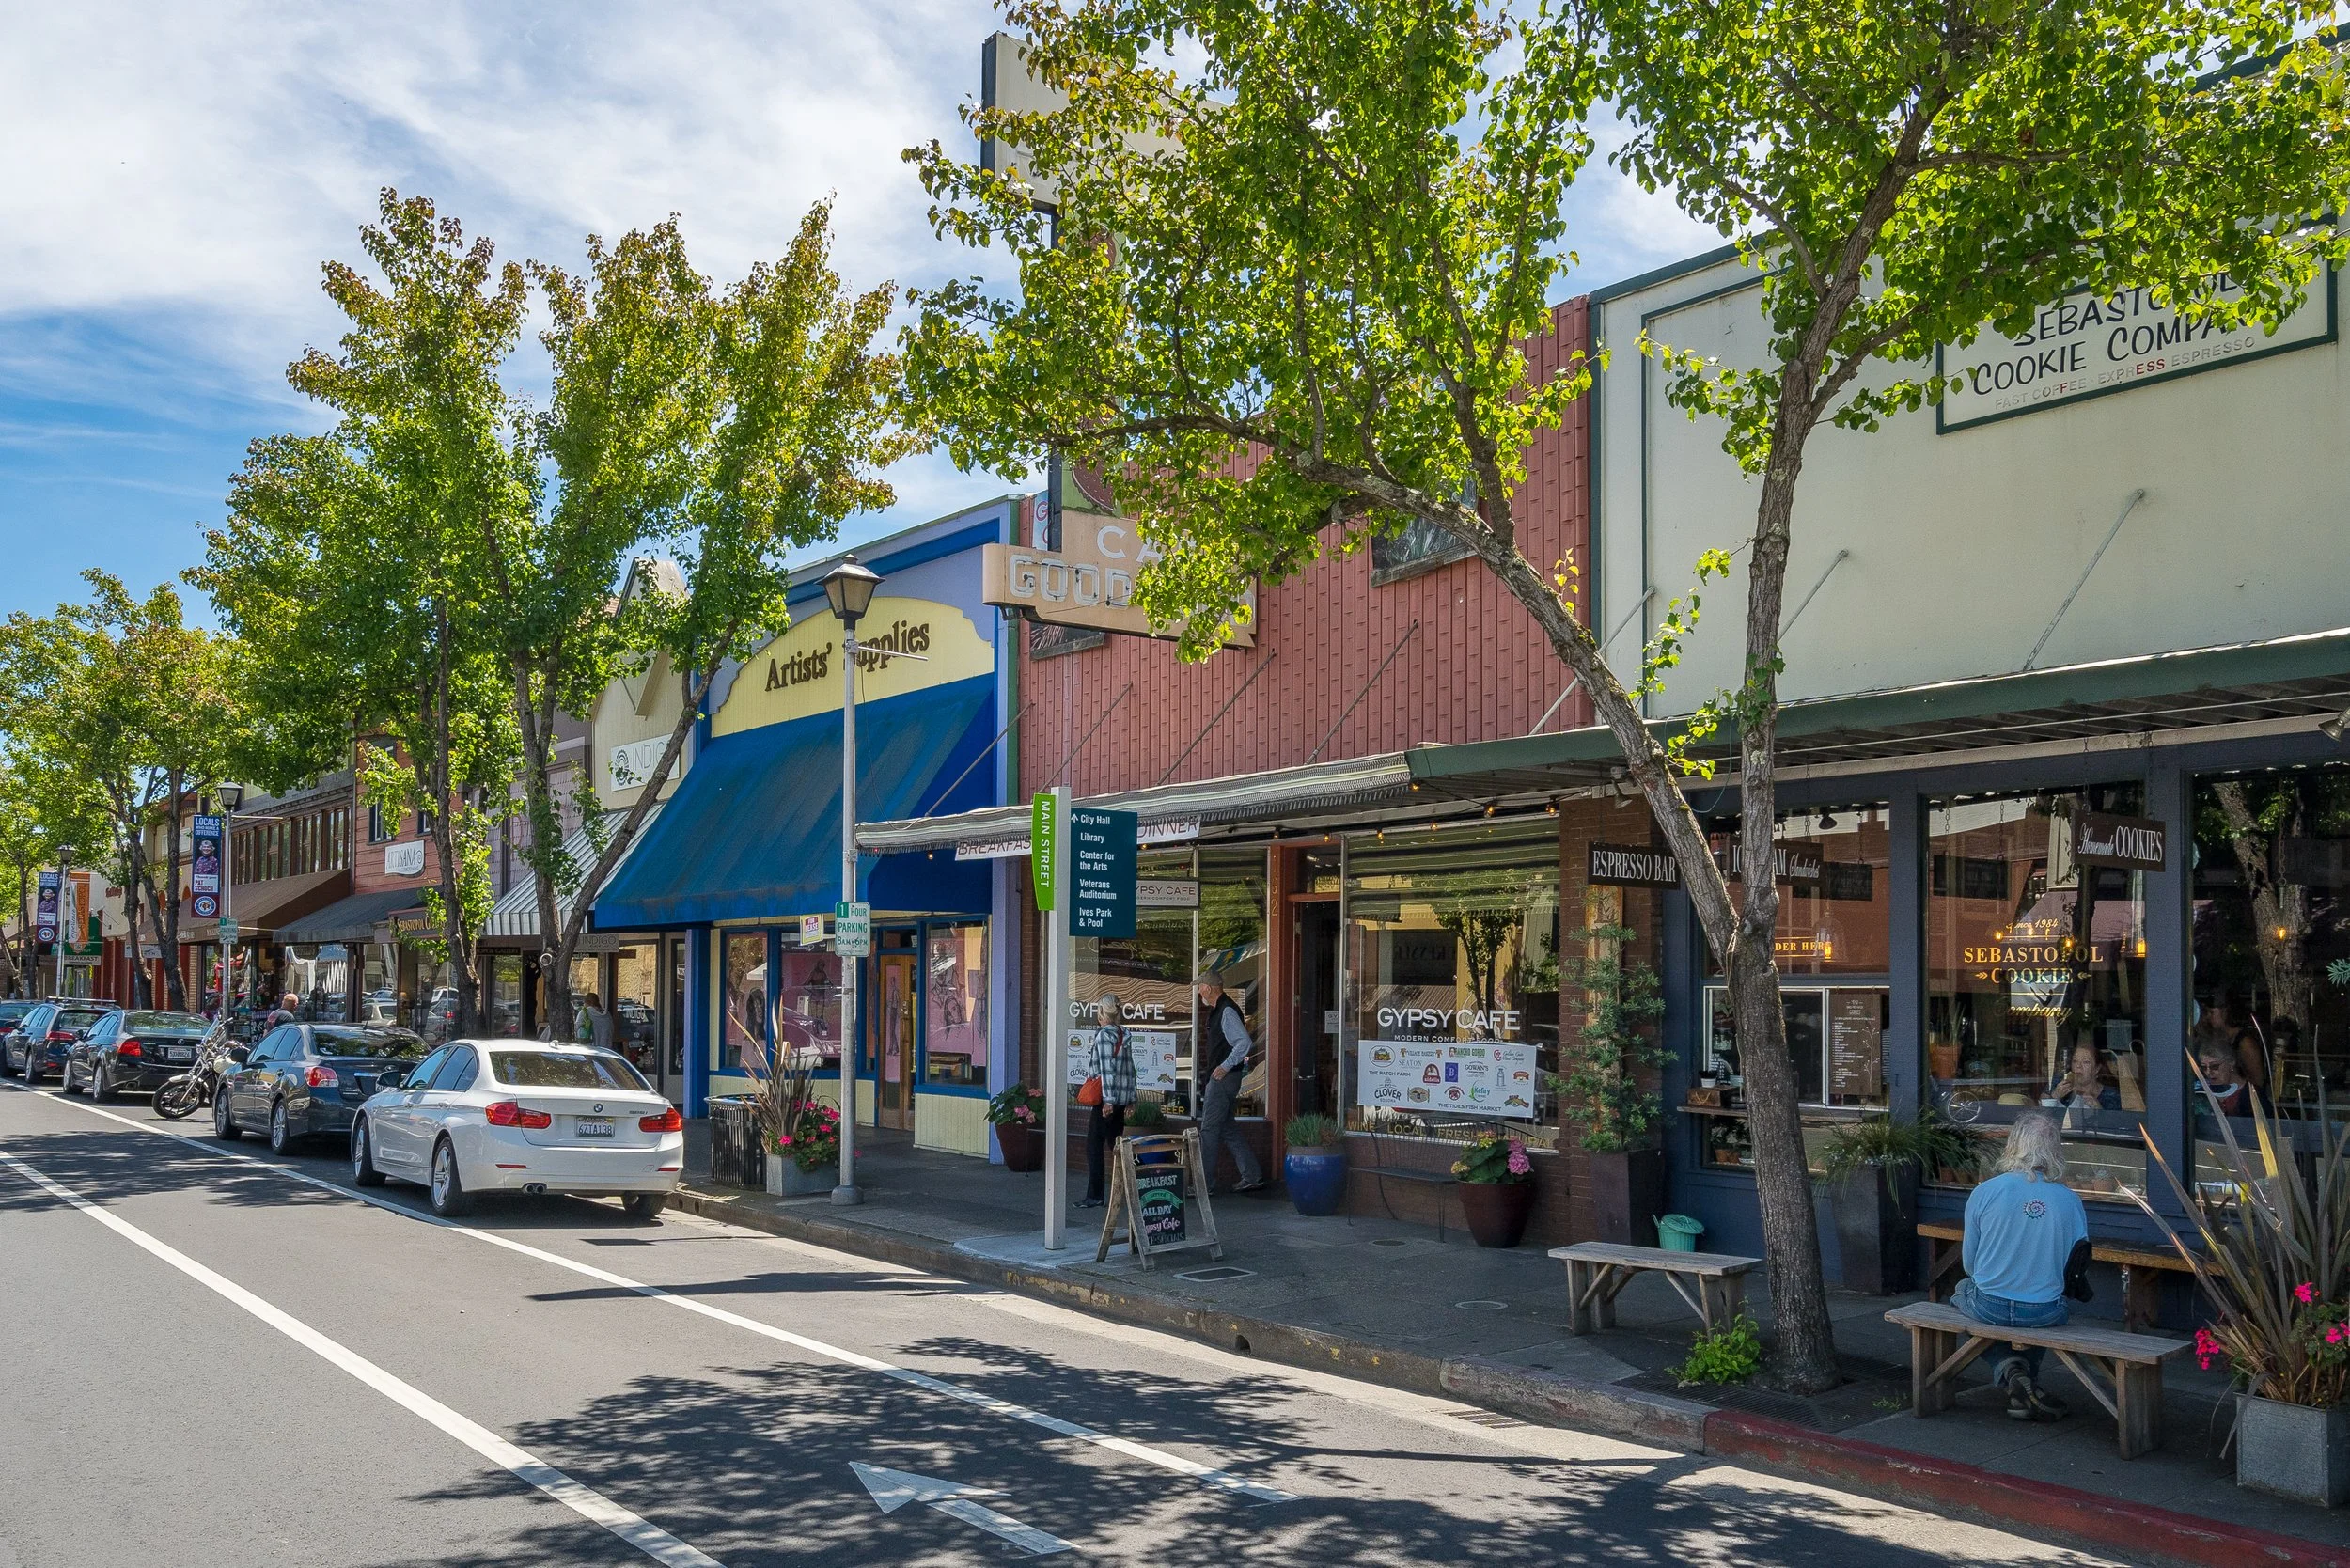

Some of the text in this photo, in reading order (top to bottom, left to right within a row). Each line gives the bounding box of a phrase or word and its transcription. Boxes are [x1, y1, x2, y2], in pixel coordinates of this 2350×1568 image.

[2014, 274, 2238, 347] EBASTOOL
[1974, 313, 2248, 396] COOKIE COMPA
[1995, 336, 2256, 411] FAST COFFEE EXPRESS ESPRESSO
[1009, 554, 1132, 608] GOOD
[765, 620, 930, 692] Artists' upplies
[633, 741, 666, 772] INDIG
[196, 817, 220, 826] LOCALS
[1041, 800, 1051, 834] MAIN
[1080, 813, 1111, 825] City Hall
[1080, 832, 1105, 844] Library
[2077, 823, 2162, 862] Homemade COOKIES
[958, 835, 1032, 855] BREAKFAS
[1080, 850, 1115, 860] Center for
[1040, 839, 1050, 887] STREET
[1079, 861, 1108, 870] the Arts
[1592, 850, 1677, 882] ESPRESSO BAR
[1079, 878, 1111, 888] Veterans
[1079, 890, 1117, 900] Auditorium
[1166, 886, 1196, 895] CAFE
[839, 904, 868, 917] 1 HOUR
[1079, 907, 1112, 917] Ives Park
[838, 921, 868, 933] PARKING
[1079, 917, 1104, 928] & Pool
[2034, 917, 2059, 929] 1984
[583, 935, 617, 945] INDIGO
[1775, 942, 1797, 951] DER
[1990, 967, 2074, 985] COOKIE
[1122, 1002, 1166, 1021] CAFE
[2002, 1000, 2074, 1027] ompany
[1377, 1007, 1521, 1030] GYPSY CAFE
[1394, 1034, 1430, 1043] MODERN
[1471, 1048, 1486, 1057] GORDO
[1374, 1088, 1402, 1101] CLOVER
[1160, 1105, 1185, 1115] BEER
[1348, 1121, 1376, 1132] WINE
[1386, 1122, 1426, 1137] LOCAL
[1136, 1174, 1178, 1190] BREAKFAST
[1143, 1204, 1173, 1217] ALL DAY
[1145, 1221, 1162, 1234] ypsy
[1162, 1217, 1181, 1231] Cafe
